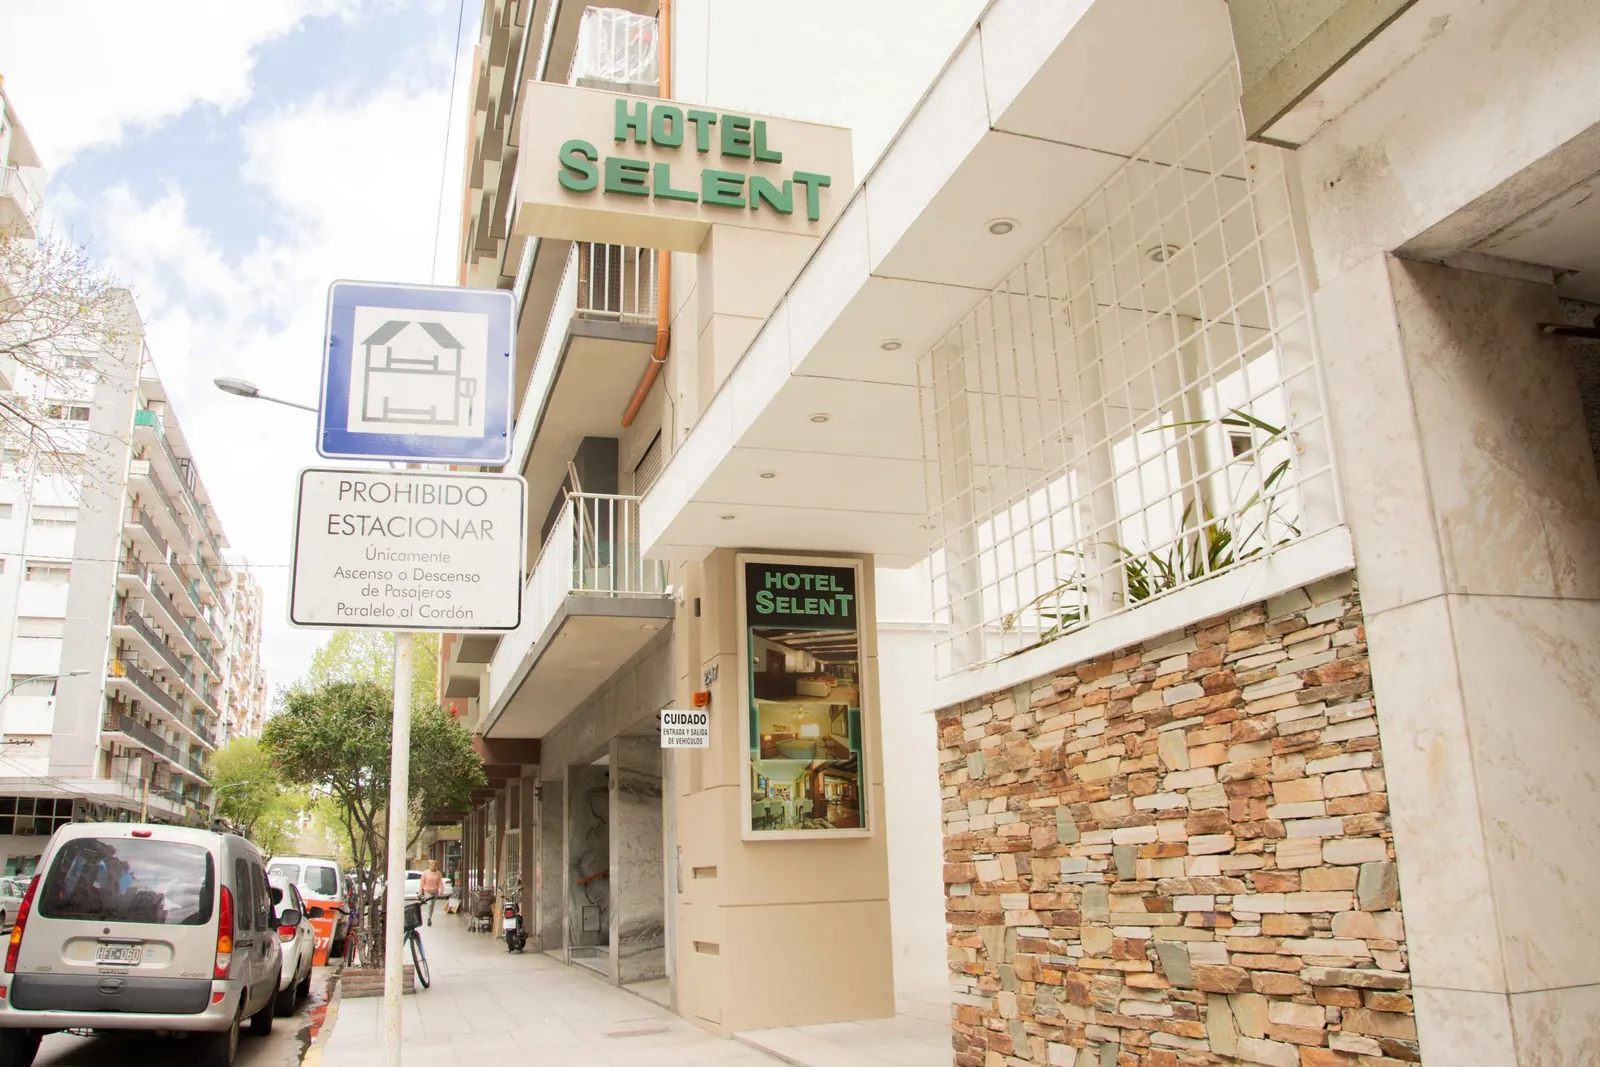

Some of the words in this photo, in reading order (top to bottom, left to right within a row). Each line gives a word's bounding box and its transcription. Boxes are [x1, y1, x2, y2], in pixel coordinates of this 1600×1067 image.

[614, 98, 782, 164] HOTEL
[558, 139, 831, 222] SELENT
[338, 480, 488, 507] PROHIBIDO
[327, 513, 495, 541] ESTACIONAR
[365, 544, 451, 563] Únicamente
[333, 566, 393, 581] Ascenso
[398, 571, 408, 581] o
[413, 568, 481, 583] Descenso
[764, 572, 844, 592] HOTEL
[361, 583, 380, 597] de
[385, 584, 452, 601] Pasajeros
[336, 602, 395, 617] Paralelo
[400, 604, 413, 618] al
[419, 605, 474, 619] Cordón
[755, 590, 853, 617] SELENT
[664, 713, 707, 725] CUIDADO
[663, 728, 685, 736] ENTRADA
[686, 728, 690, 736] Y
[668, 737, 675, 745] DE
[676, 737, 703, 745] VEHICULOS
